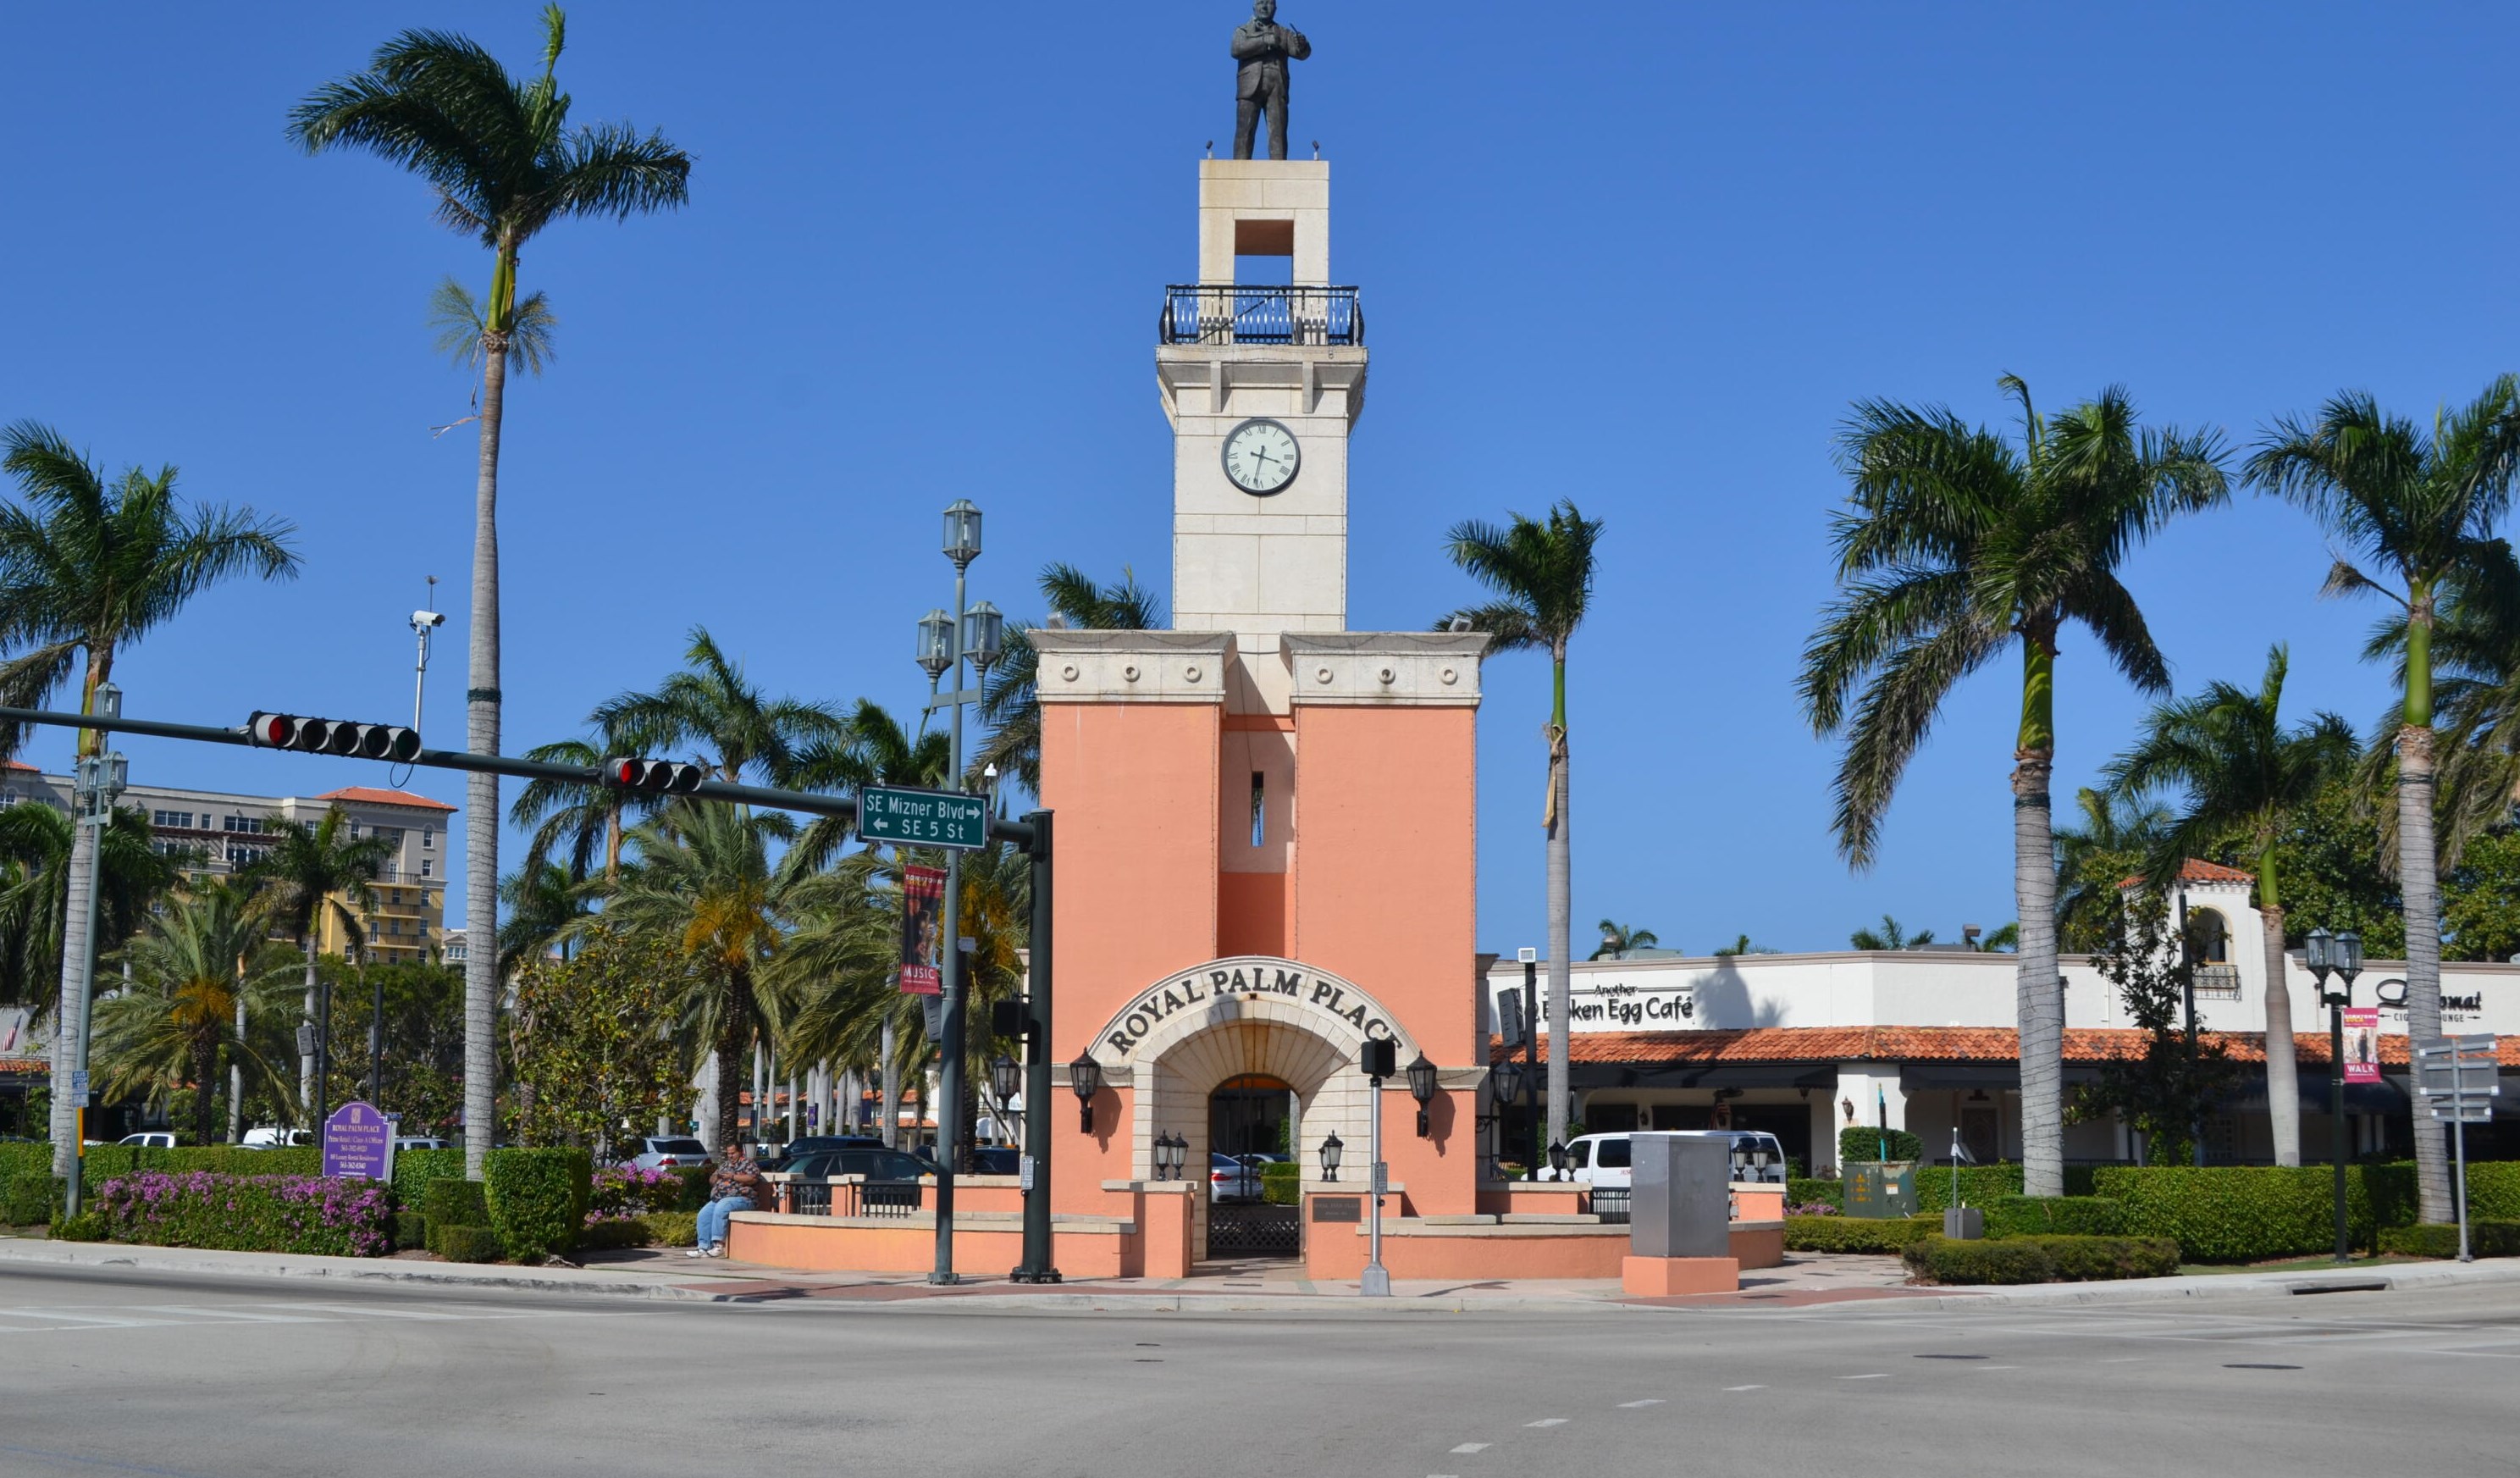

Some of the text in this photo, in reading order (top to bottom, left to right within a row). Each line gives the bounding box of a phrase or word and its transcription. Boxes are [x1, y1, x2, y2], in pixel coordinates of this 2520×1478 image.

[866, 794, 964, 820] SE Mizner Blvd
[902, 819, 964, 839] SE 5 St
[904, 966, 935, 979] MUSIC
[1594, 983, 1639, 997] Another
[1107, 979, 1206, 1056] ROYAL
[1209, 967, 1301, 996] PALM
[1608, 998, 1642, 1025] Egg
[1646, 995, 1694, 1021] Café
[2346, 1064, 2375, 1073] WALK
[348, 1124, 362, 1132] PALM
